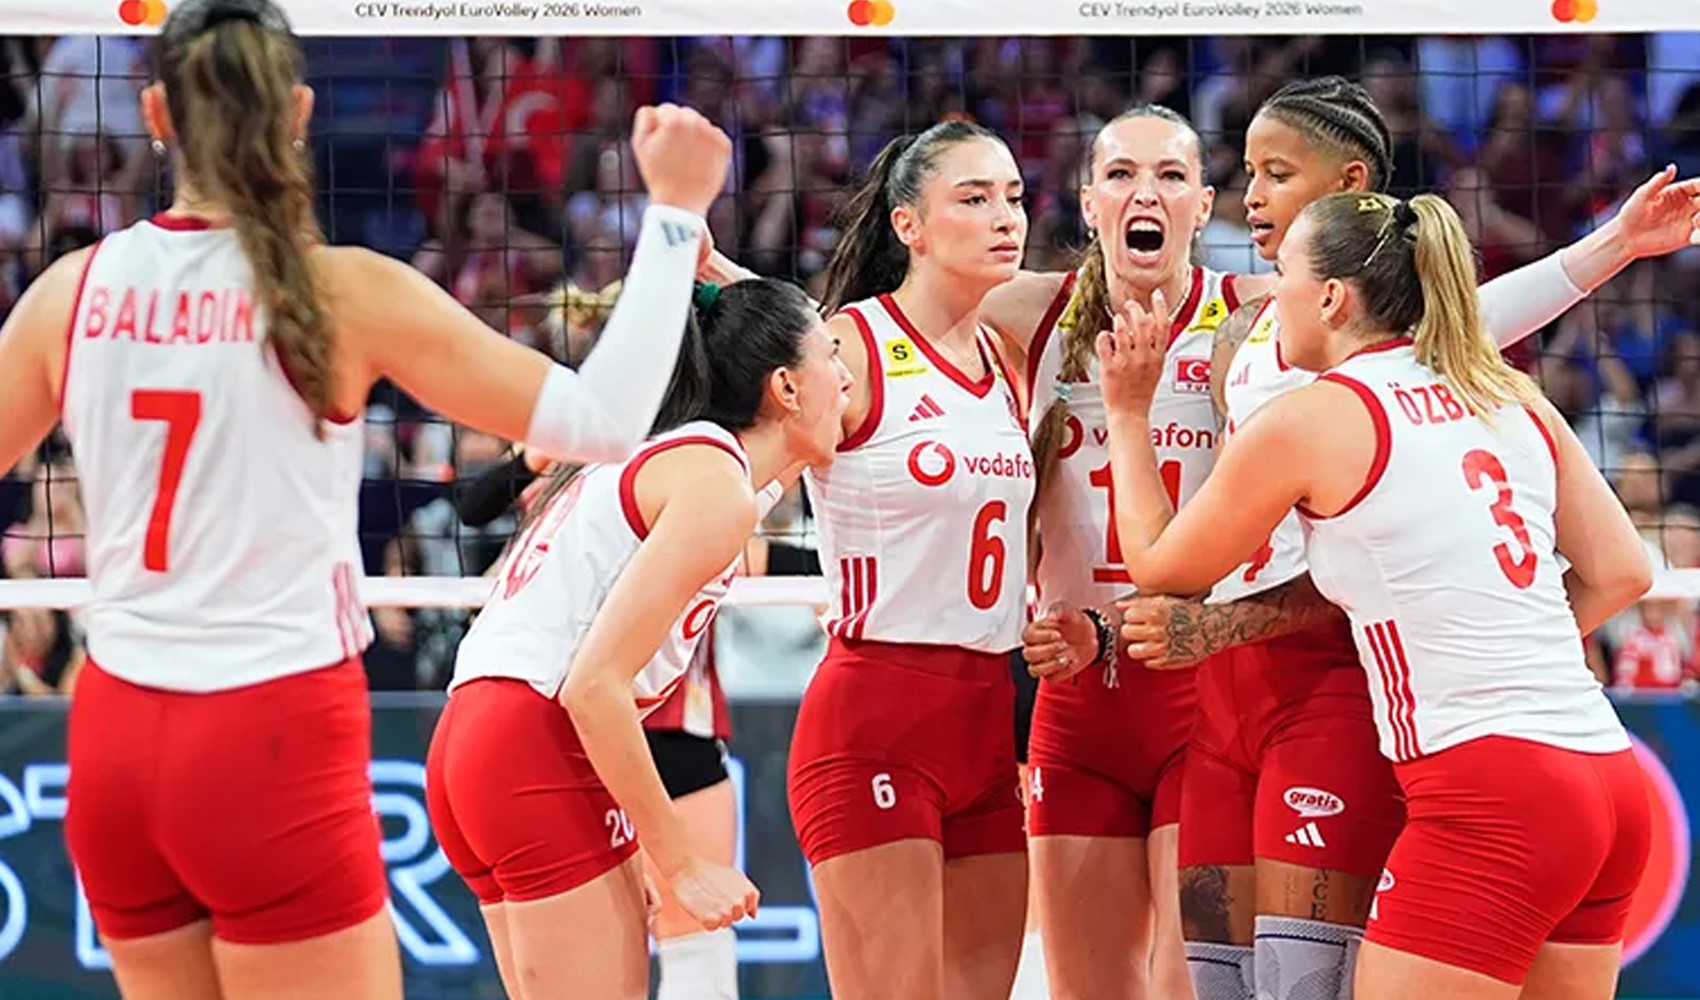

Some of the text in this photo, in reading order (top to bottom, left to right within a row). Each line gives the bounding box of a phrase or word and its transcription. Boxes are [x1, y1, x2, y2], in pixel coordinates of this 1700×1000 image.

[355, 3, 641, 20] CEV Trendyol EuroVolley 2026 Women
[1079, 3, 1363, 18] CEV Trendyol EuroVolley 2026 Women
[892, 344, 908, 360] S
[1387, 382, 1478, 426] ÖZB
[1093, 421, 1213, 449] vafon
[131, 388, 202, 572] 7
[1462, 448, 1538, 590] 3
[967, 500, 1007, 610] 6
[871, 773, 896, 809] 6
[1289, 791, 1339, 810] gratis
